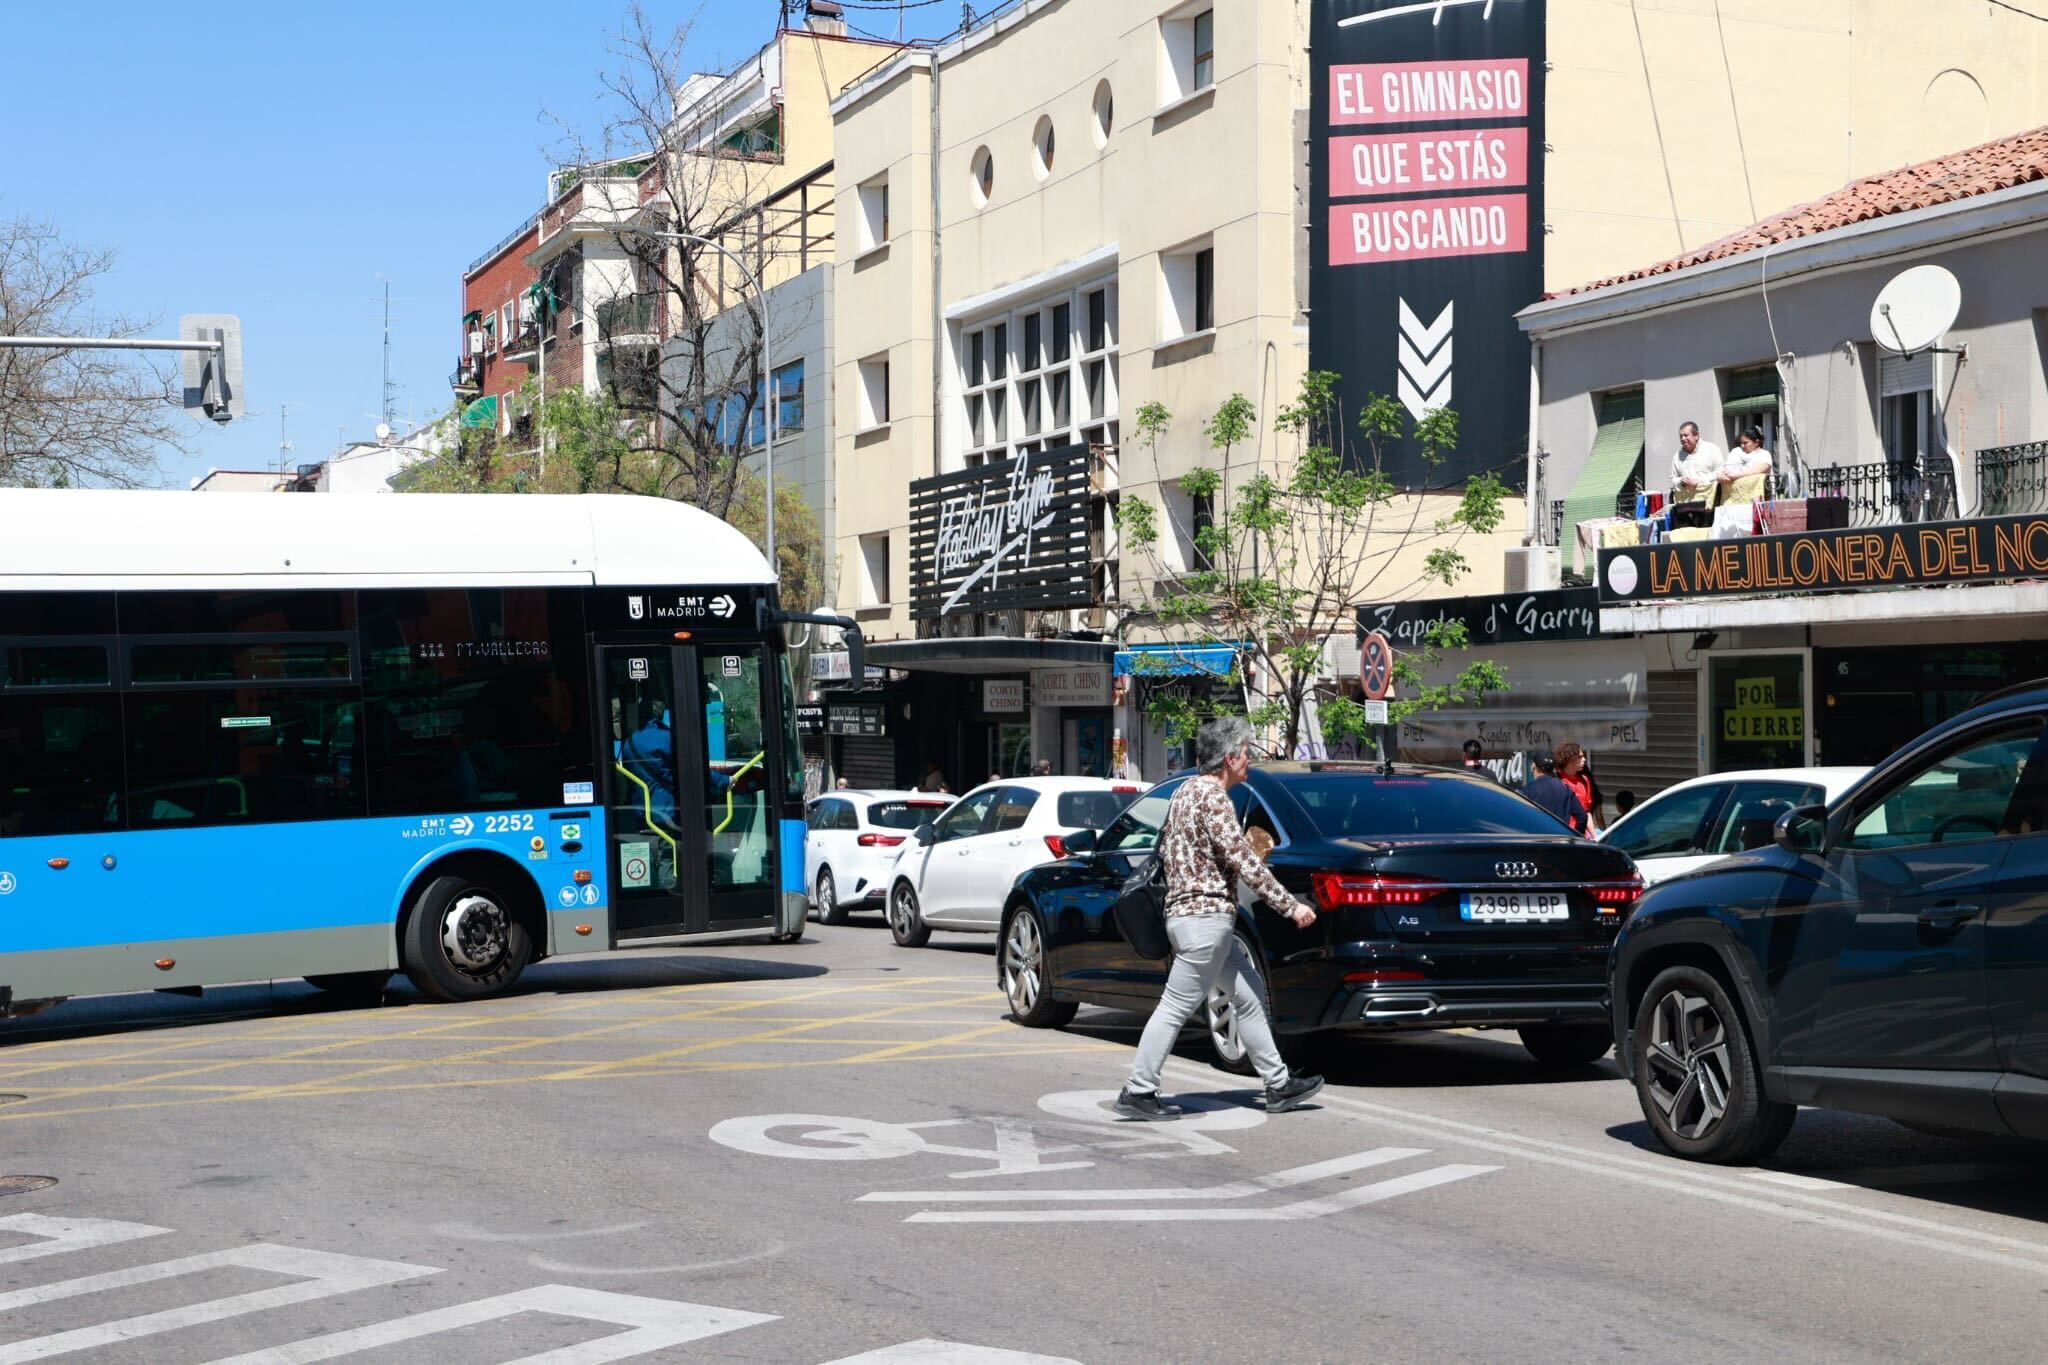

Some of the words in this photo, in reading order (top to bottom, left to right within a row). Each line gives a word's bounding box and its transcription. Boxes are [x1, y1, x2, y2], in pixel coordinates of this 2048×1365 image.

[1336, 73, 1374, 114] EL
[1382, 69, 1522, 113] GIMNASIO
[1352, 143, 1411, 186] QUE
[1419, 132, 1507, 182] ESTÁS
[1352, 205, 1507, 254] BUSCANDO
[1650, 550, 1688, 593] LA
[1695, 531, 1915, 592] MEJILLONERA
[1919, 527, 1990, 577] DEL
[678, 597, 705, 606] EMT
[657, 607, 706, 617] MADRID
[989, 685, 1019, 695] CORTE
[1041, 673, 1068, 690] CORTE
[1073, 672, 1101, 689] CHINO
[989, 698, 1020, 708] CHINO
[1738, 685, 1774, 705] POR
[1610, 725, 1641, 743] PIEL
[1726, 716, 1802, 736] CIERRE
[422, 819, 446, 828] EMT
[485, 814, 534, 833] 2252
[402, 828, 446, 838] MADRID
[1474, 895, 1520, 915] 2396
[1527, 895, 1561, 914] LBP
